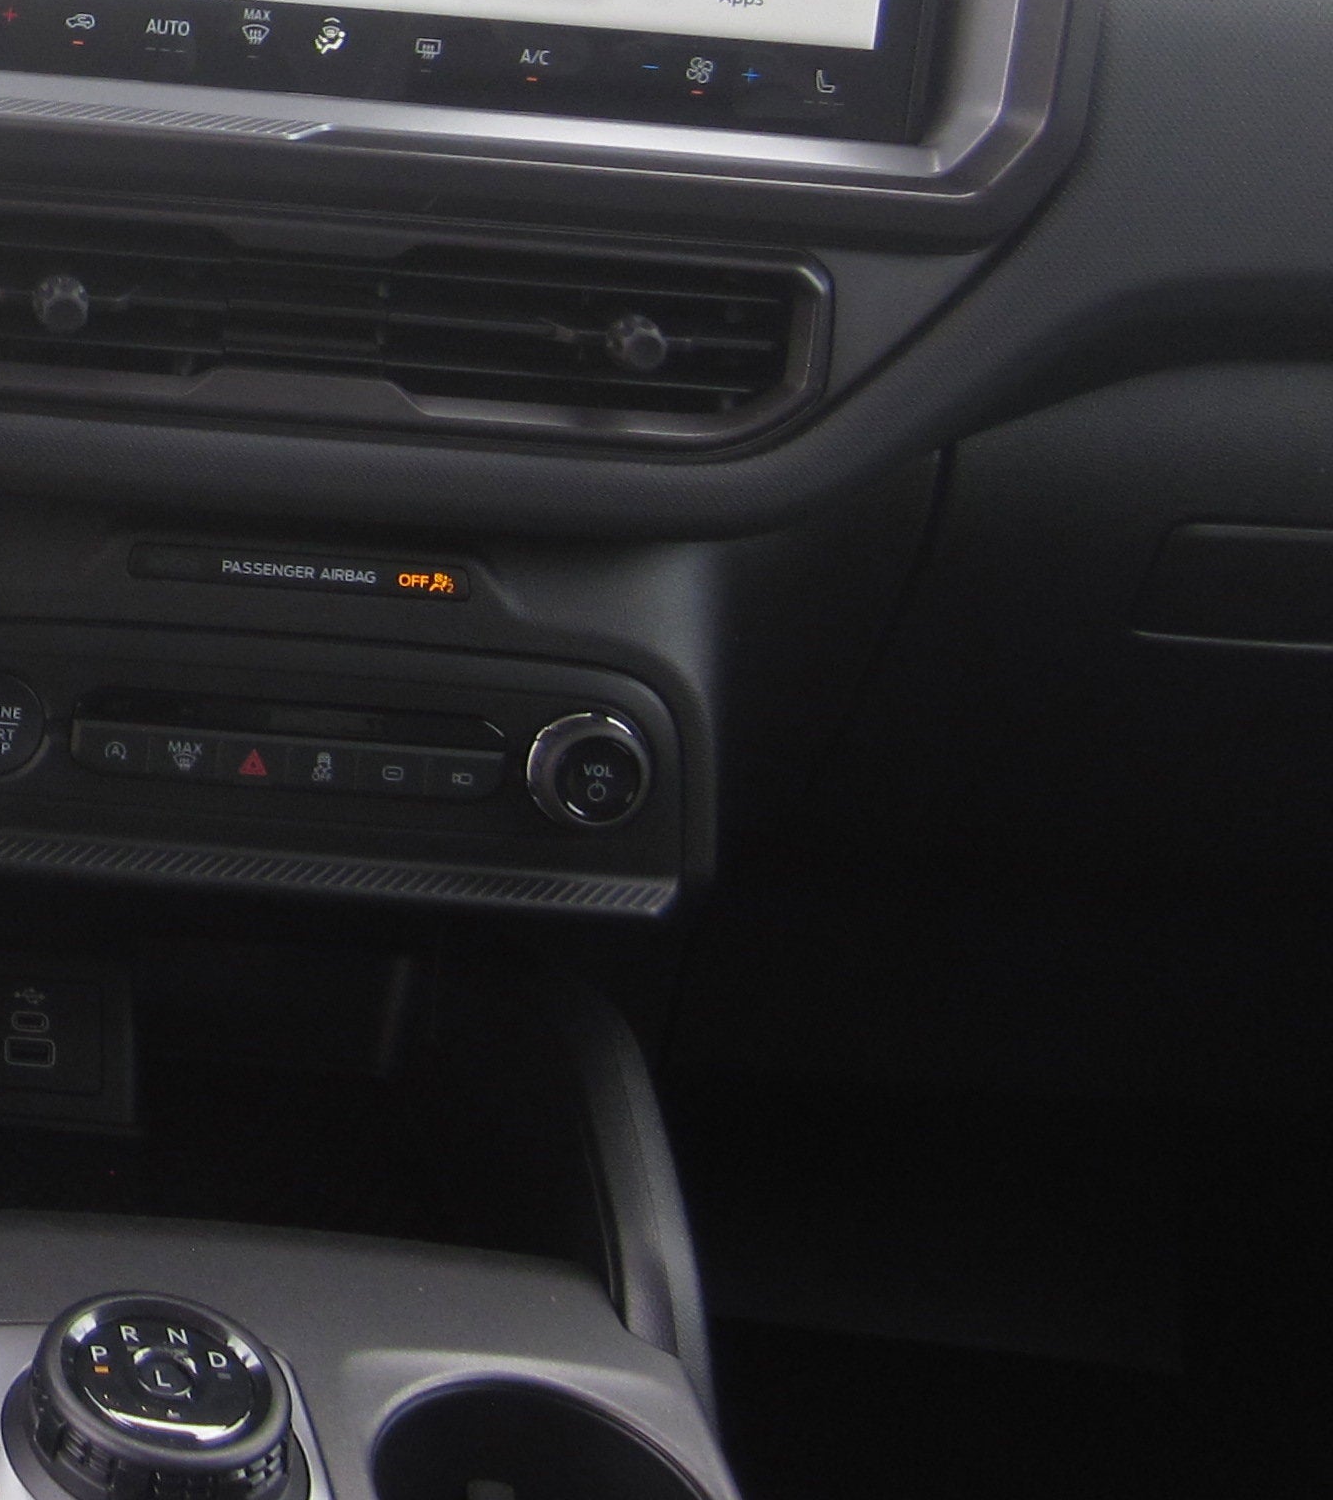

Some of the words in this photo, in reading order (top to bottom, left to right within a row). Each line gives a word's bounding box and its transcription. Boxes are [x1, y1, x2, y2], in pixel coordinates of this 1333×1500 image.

[243, 7, 271, 21] MAX
[145, 18, 190, 37] AUTO
[519, 48, 551, 66] A/C
[221, 559, 315, 580] PASSENGER
[319, 568, 377, 584] AIRBAG
[397, 573, 429, 589] OFF
[168, 740, 203, 755] MAX
[583, 763, 613, 778] VOL
[120, 1325, 140, 1342] R
[167, 1327, 189, 1345] N
[90, 1345, 108, 1362] P
[207, 1351, 228, 1368] D
[154, 1369, 172, 1388] L
